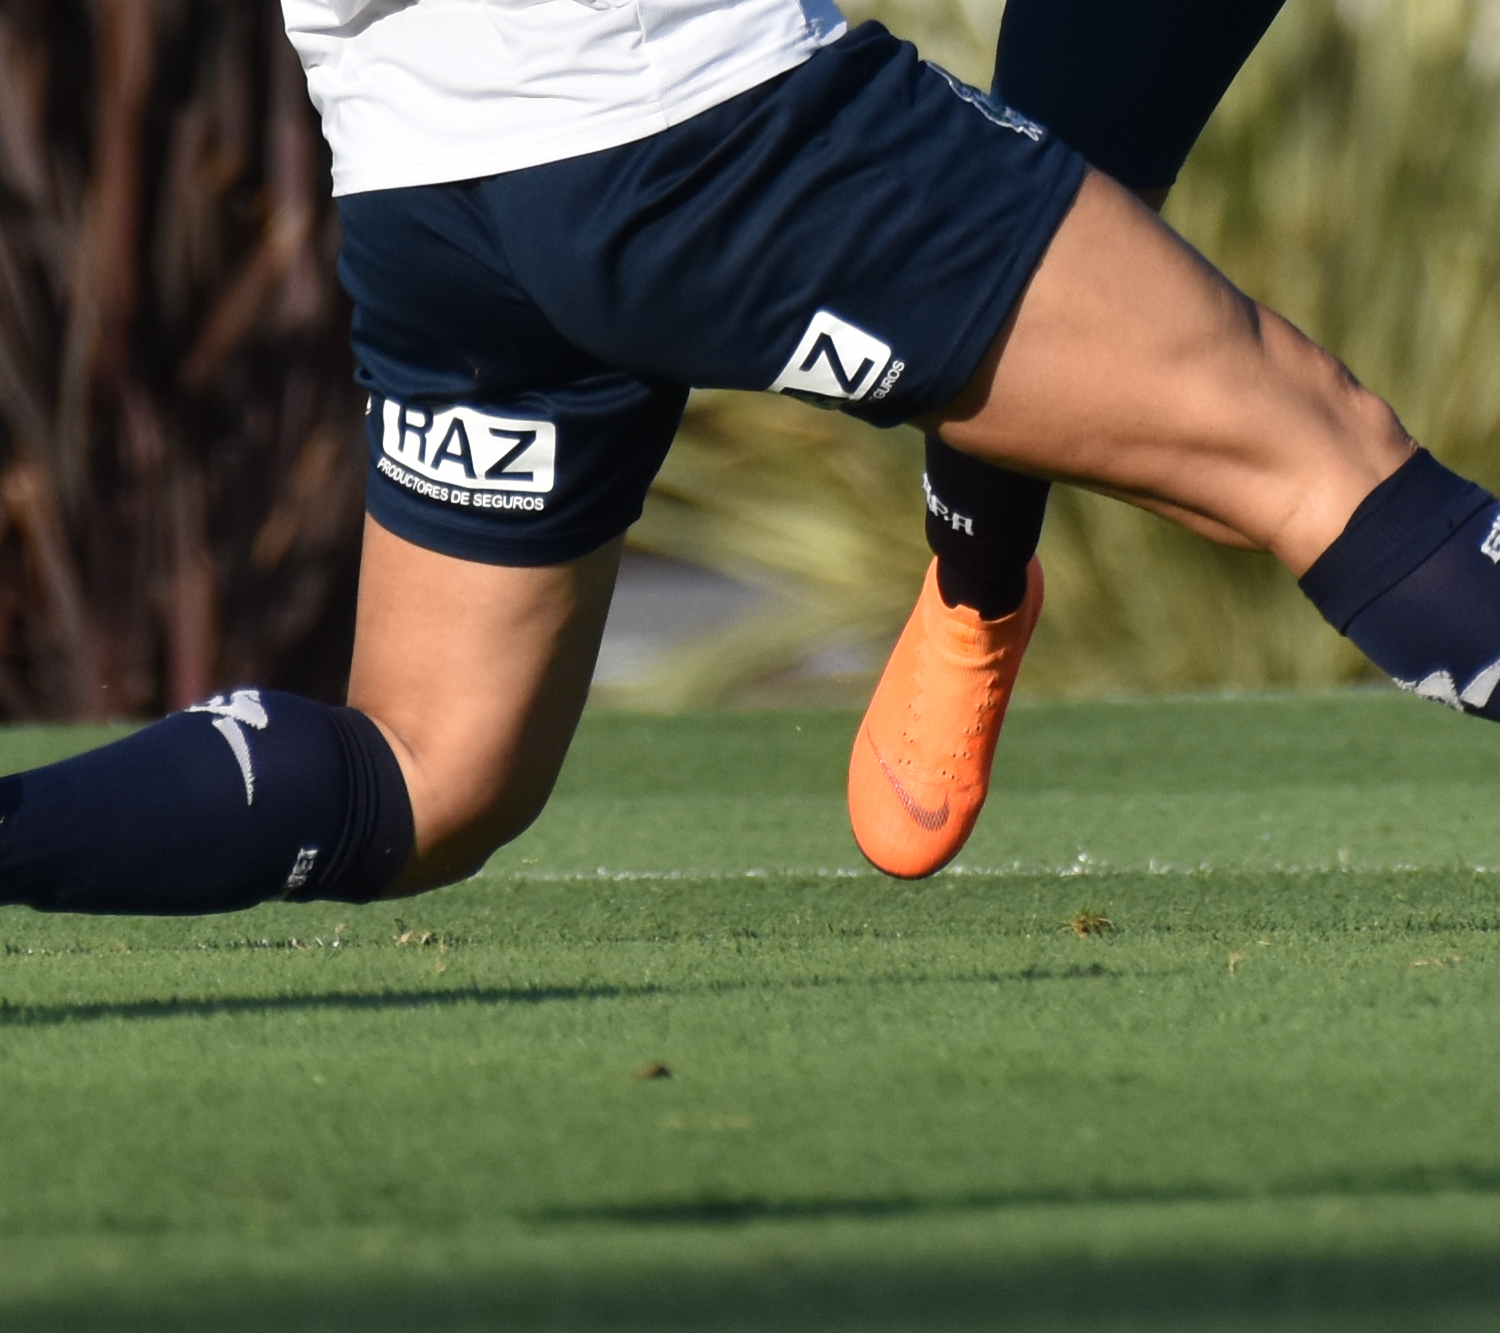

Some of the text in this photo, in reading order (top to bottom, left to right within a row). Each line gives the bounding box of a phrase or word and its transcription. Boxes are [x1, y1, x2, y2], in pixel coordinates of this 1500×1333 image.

[869, 360, 905, 400] GUROS
[397, 406, 538, 482] RAZ
[376, 456, 545, 511] PRODUCTORES DE SEGUROS
